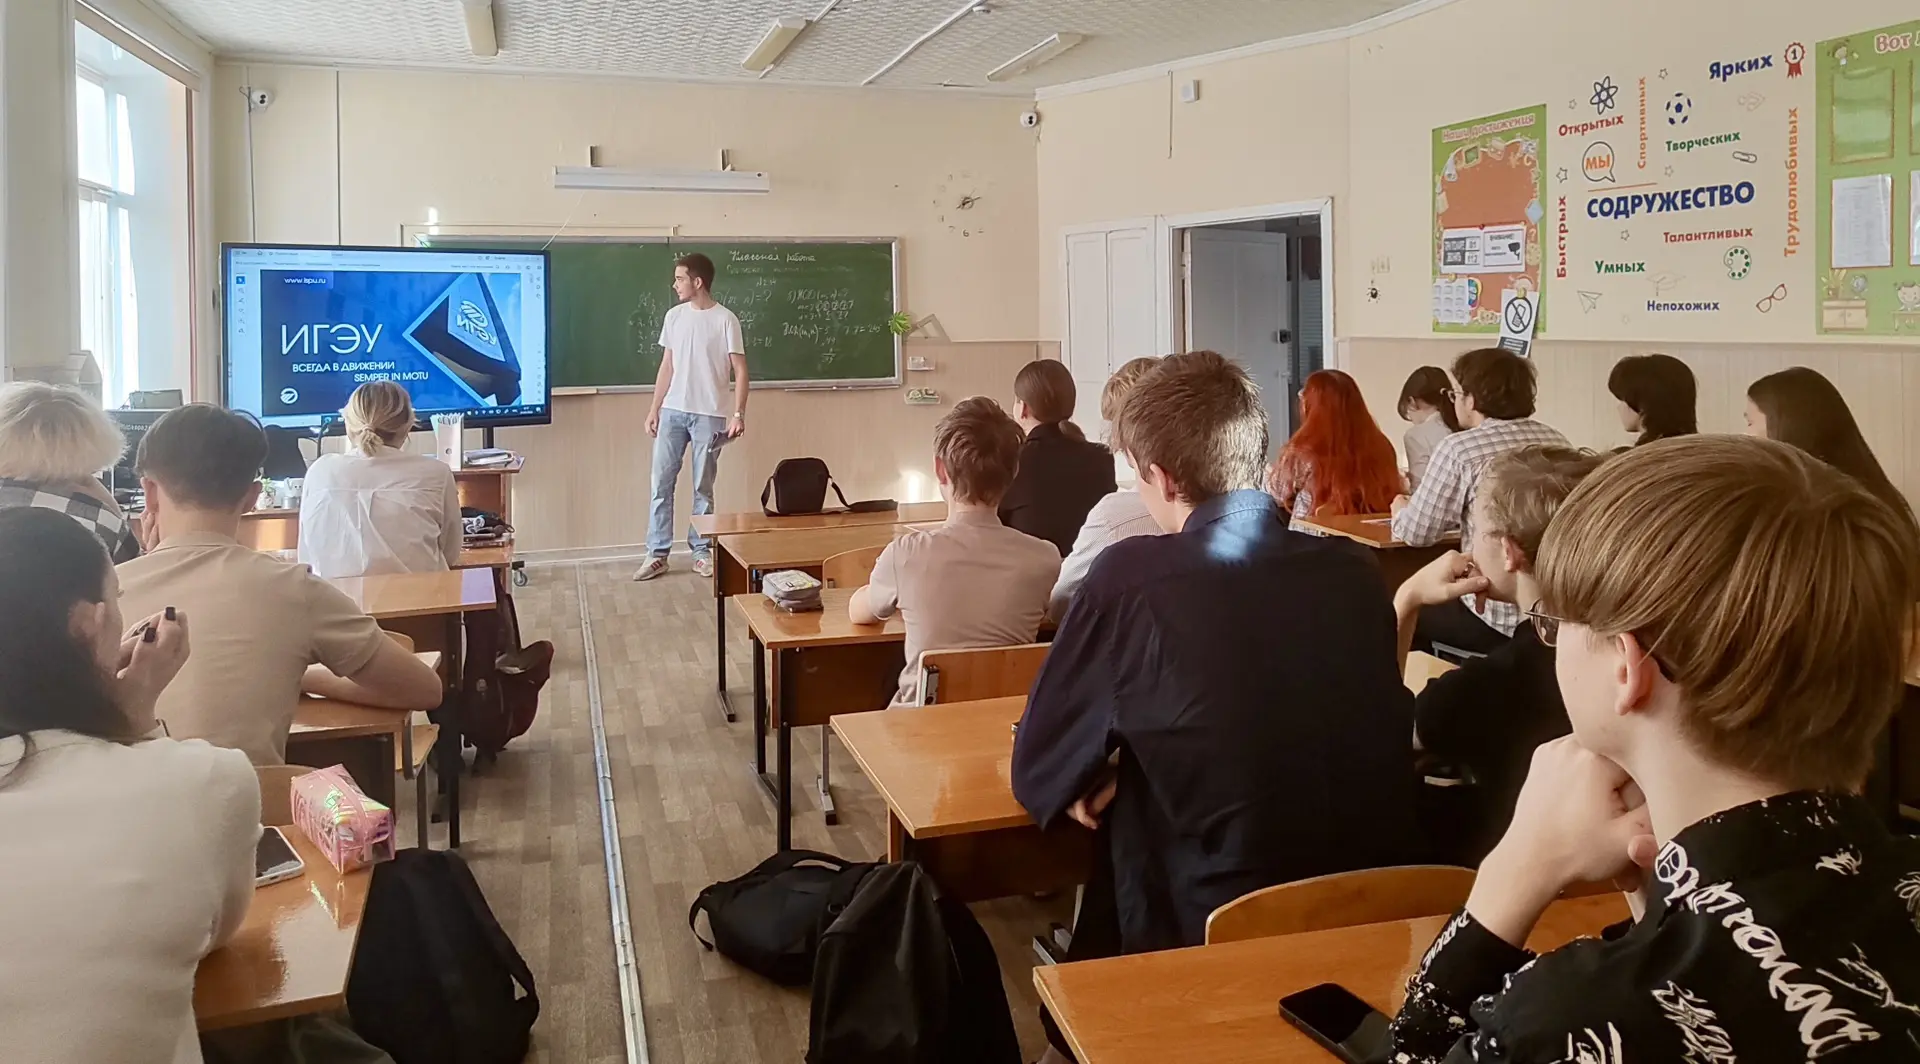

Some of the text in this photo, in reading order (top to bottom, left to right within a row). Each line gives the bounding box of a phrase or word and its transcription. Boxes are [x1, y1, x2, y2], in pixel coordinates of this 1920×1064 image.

[1791, 48, 1797, 60] 1
[1875, 33, 1913, 54] Вот
[1709, 54, 1773, 82] Ярких
[1558, 114, 1624, 136] Открытых
[1637, 76, 1649, 169] Спортивных
[1665, 131, 1741, 152] Творческих
[1784, 106, 1800, 257] Трудолюбивых
[1587, 181, 1755, 219] СОДРУЖЕСТВО
[1556, 195, 1568, 278] Быстрых
[1663, 227, 1753, 243] Талантливых
[1595, 260, 1645, 274] Умных
[284, 277, 326, 285] www.ispu.ru
[1646, 300, 1720, 312] Непохожих
[281, 323, 383, 355] ИГЭУ
[292, 361, 395, 373] ВСЕГДА В ДВИЖЕНИИ
[354, 371, 429, 382] SEMPER IN MOTU
